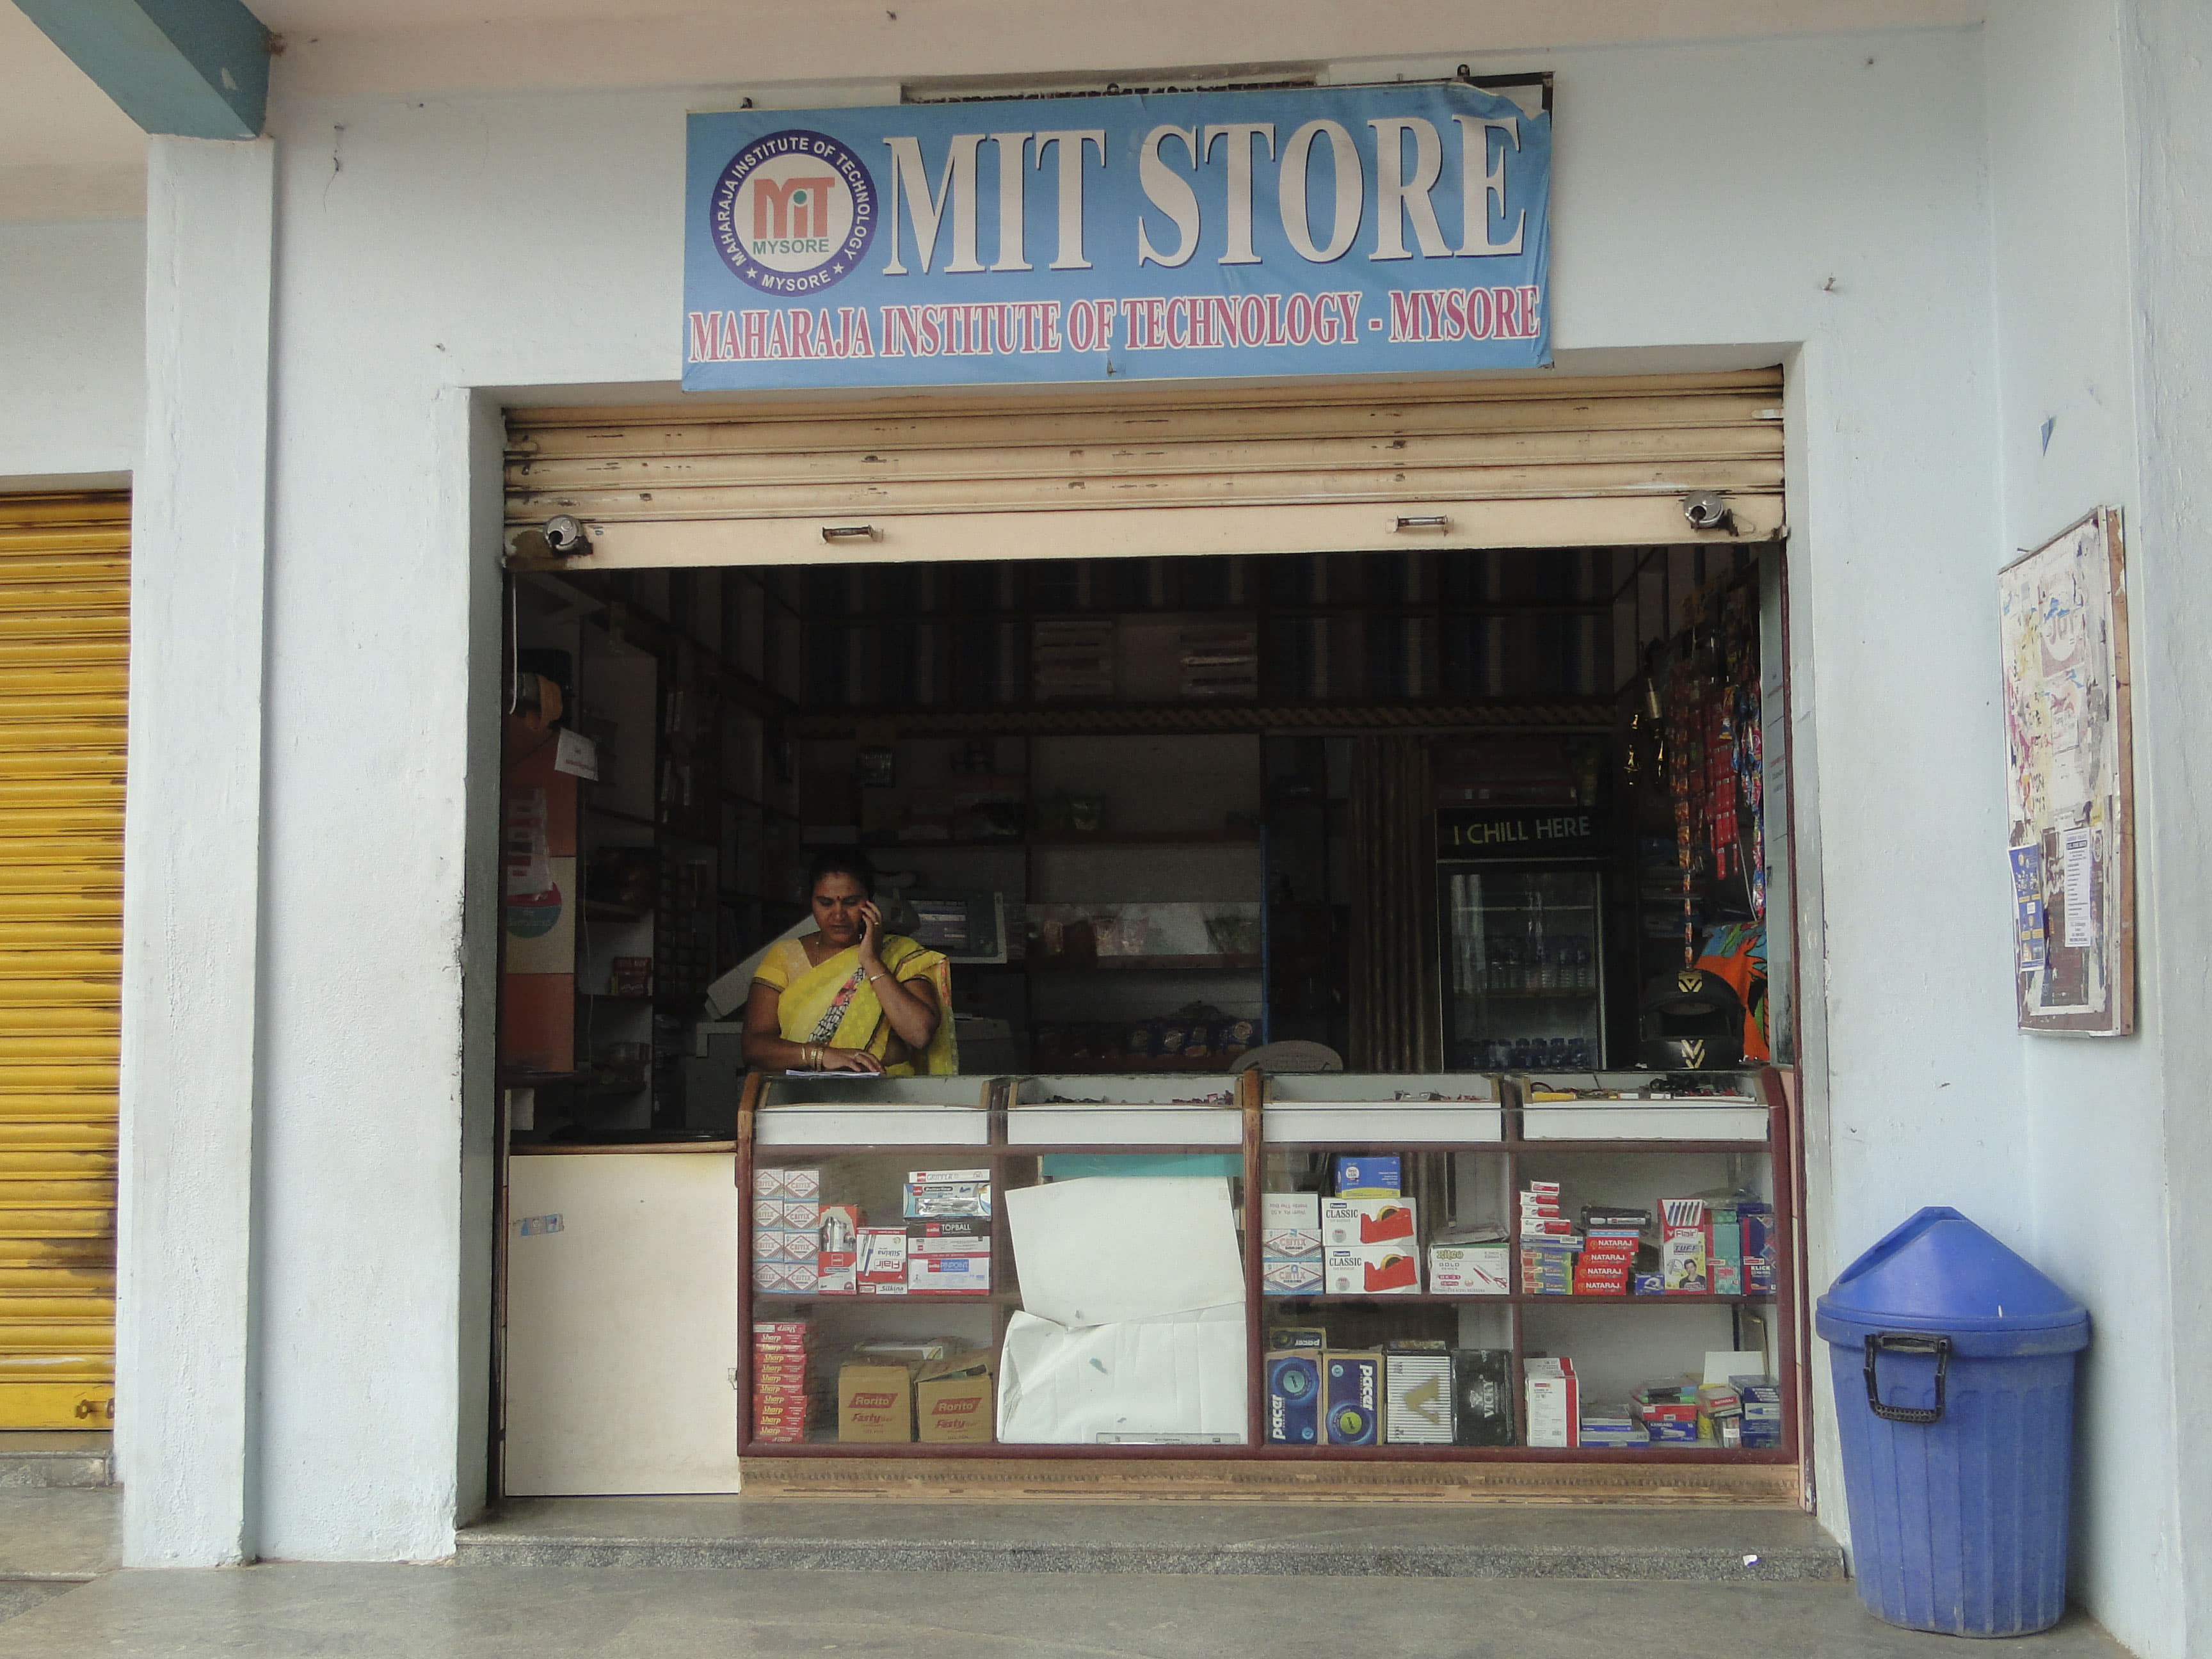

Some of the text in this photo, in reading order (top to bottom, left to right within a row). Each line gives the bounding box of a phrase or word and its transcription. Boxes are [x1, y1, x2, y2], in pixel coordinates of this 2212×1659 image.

[883, 113, 1526, 275] MIT STORE
[717, 137, 870, 267] MAHARAJA INSTITUTE OF TECHNOLOGY
[753, 239, 830, 255] MYSORE
[762, 269, 831, 291] MYSORE
[688, 307, 874, 363] MAHARAJA
[880, 301, 1062, 357] INSTITUTE
[1067, 300, 1116, 351] OF
[1123, 291, 1363, 350] TECHNOLOGY
[1388, 285, 1539, 343] MYSORE
[1454, 816, 1591, 845] I CHILL HERE
[1326, 1209, 1358, 1218] CLASSIC
[876, 1260, 900, 1269] Flair
[1329, 1258, 1362, 1266] CLASSIC
[761, 1334, 781, 1342] Sharp
[764, 1354, 783, 1362] Sharp
[761, 1374, 781, 1382] Sharp
[760, 1384, 780, 1393] Sharp
[1359, 1364, 1374, 1411] pacer
[764, 1395, 784, 1404] Sharp
[856, 1397, 890, 1405] Rorito
[763, 1406, 783, 1415] Sharp
[939, 1402, 974, 1411] Rorito
[760, 1416, 781, 1425] Sharp
[1270, 1394, 1285, 1439] pacer
[760, 1427, 780, 1435] Sharp
